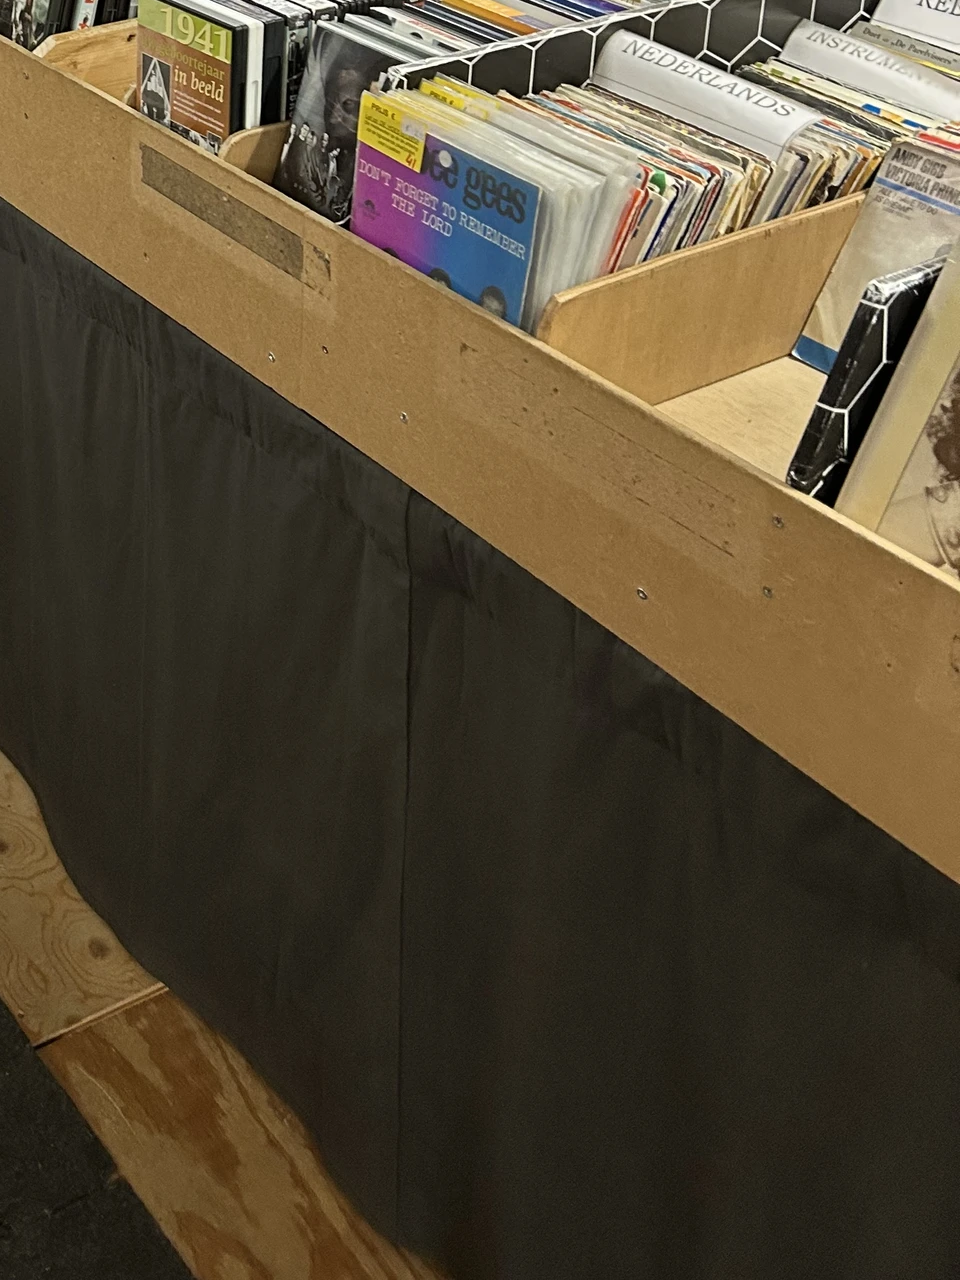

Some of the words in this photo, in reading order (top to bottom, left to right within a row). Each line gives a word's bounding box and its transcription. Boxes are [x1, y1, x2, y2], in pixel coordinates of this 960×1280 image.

[160, 6, 231, 65] 1941
[158, 44, 225, 81] geboortejaar
[621, 39, 796, 118] NEDERLANDS
[174, 65, 188, 86] in
[190, 71, 224, 103] beeld
[371, 102, 389, 118] PRIJS
[884, 162, 932, 194] VICTORIA
[891, 147, 924, 170] ANDY
[920, 158, 948, 179] GIBB
[359, 159, 391, 187] DON'T
[394, 176, 440, 212] FORGET
[442, 202, 458, 221] TO
[458, 211, 527, 261] REMEMBER
[391, 192, 416, 218] THE
[421, 209, 453, 238] LORD
[462, 166, 528, 225] gees
